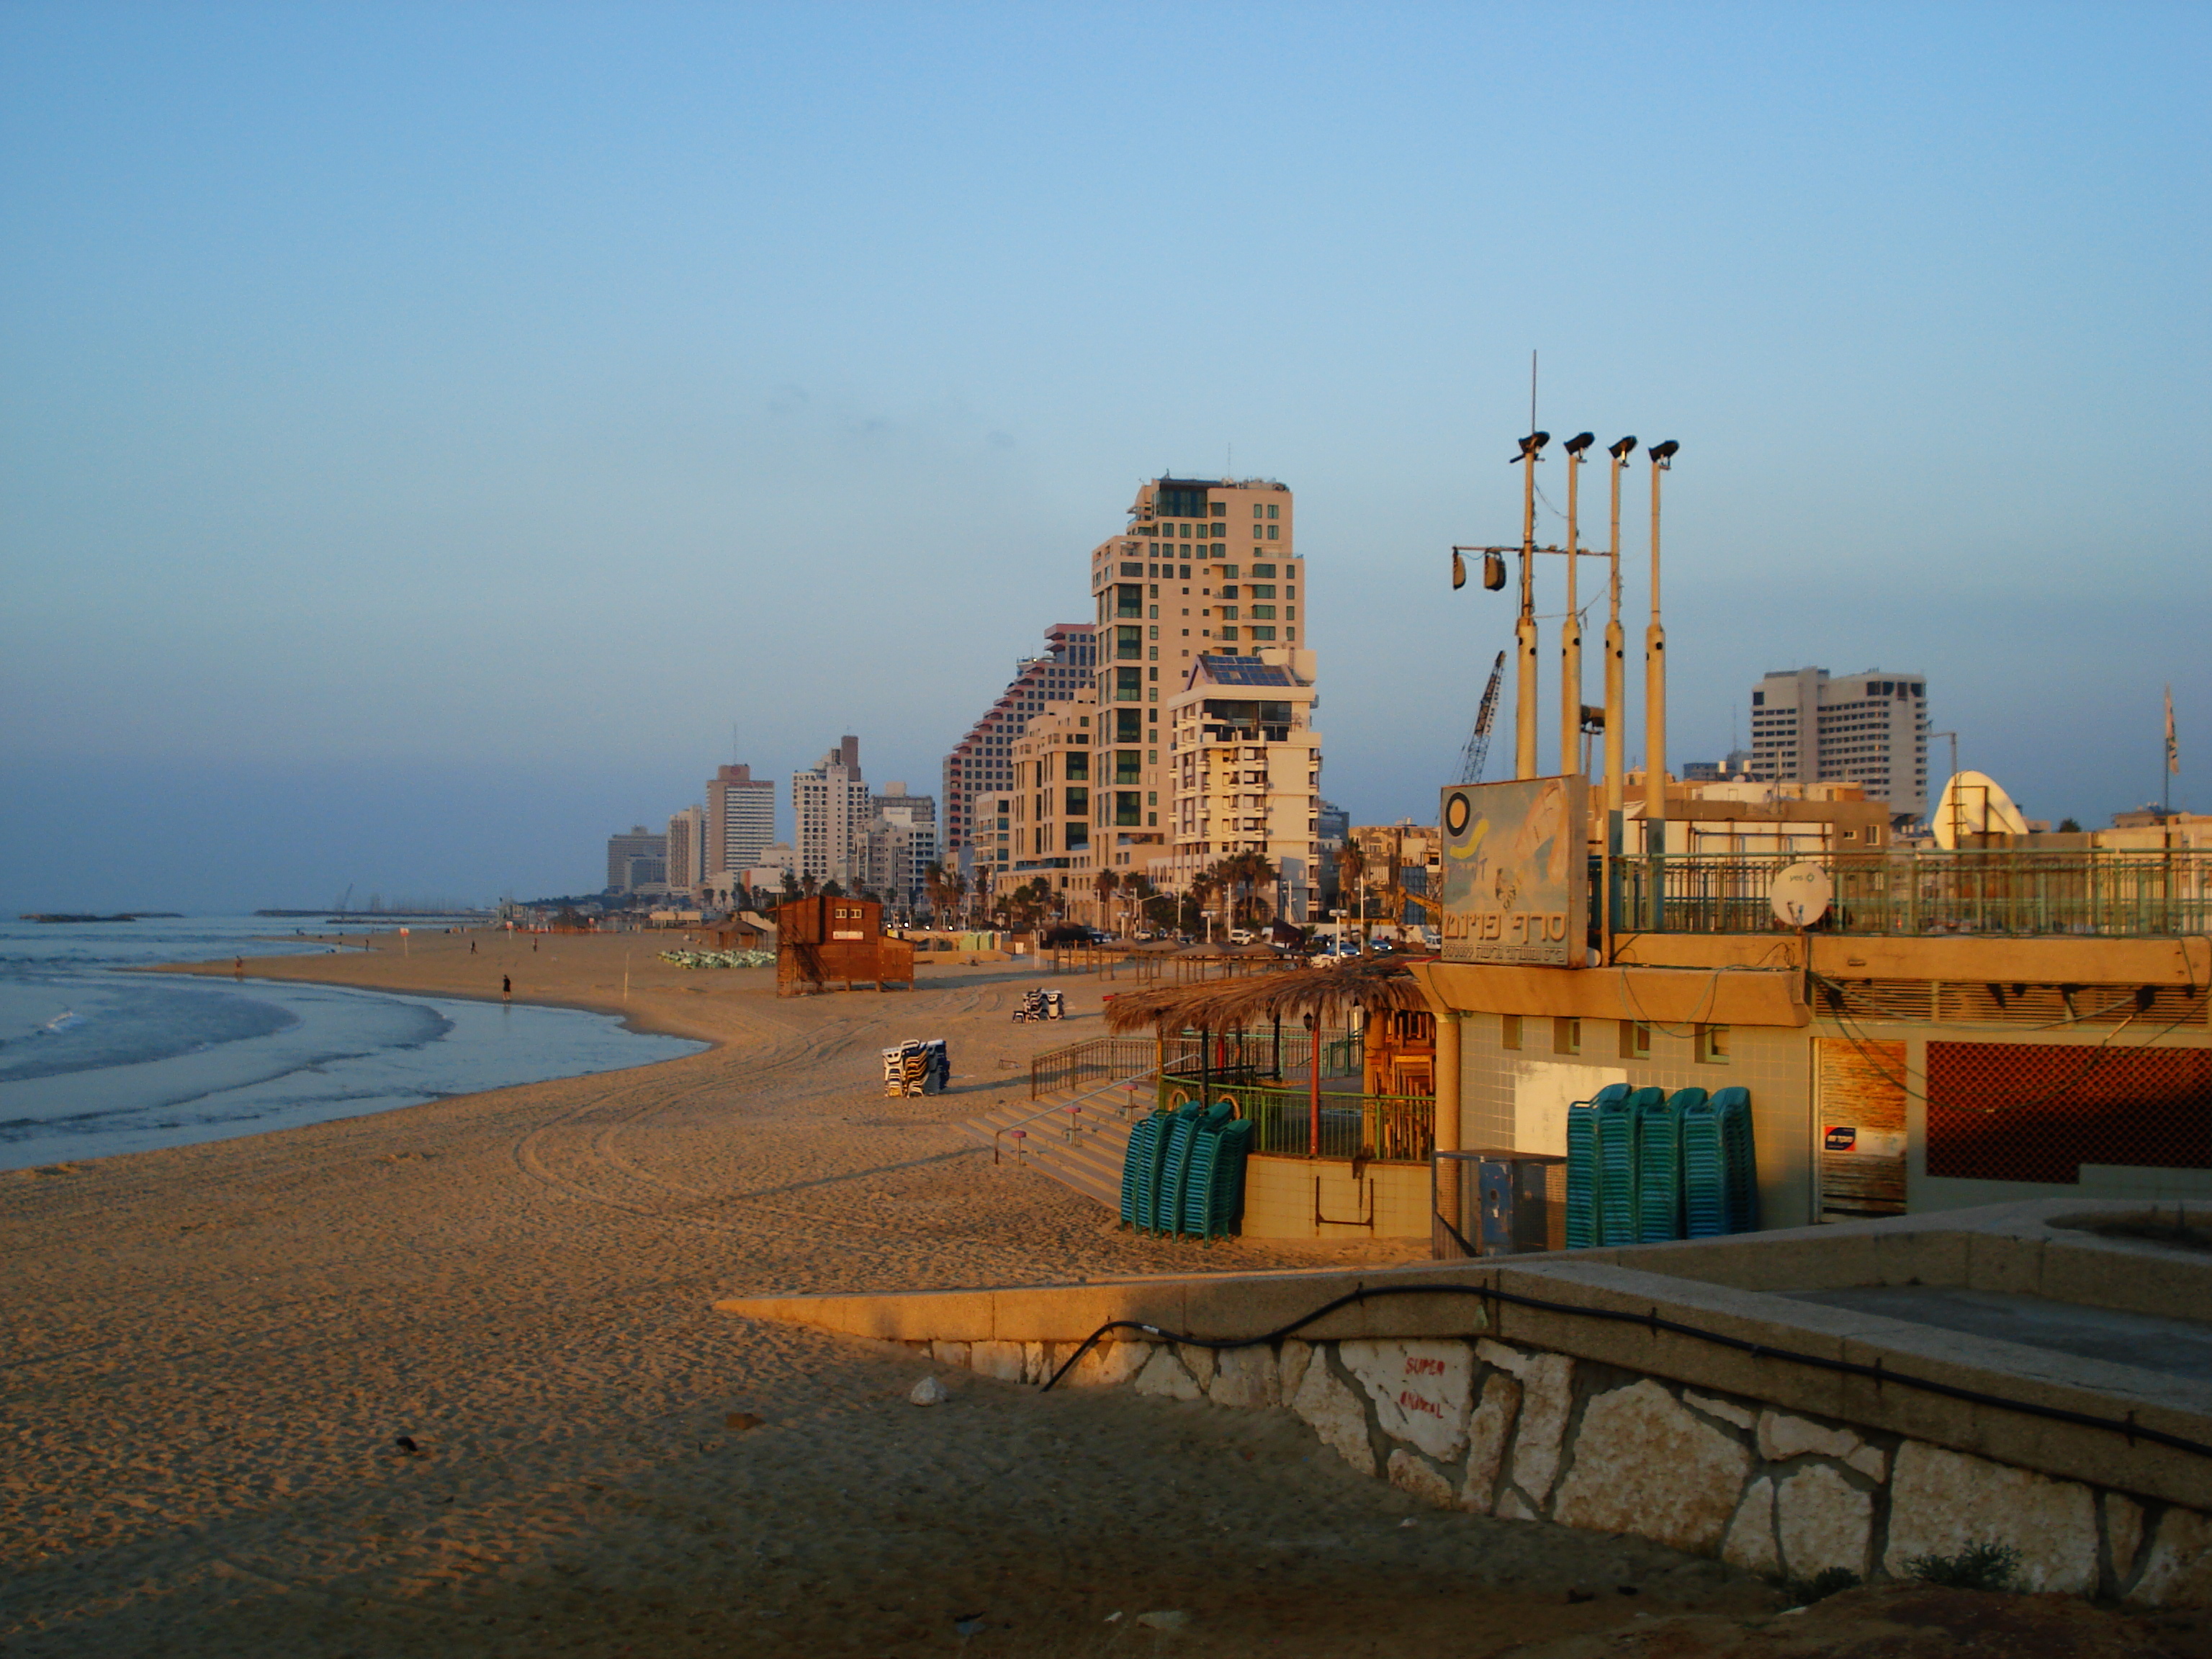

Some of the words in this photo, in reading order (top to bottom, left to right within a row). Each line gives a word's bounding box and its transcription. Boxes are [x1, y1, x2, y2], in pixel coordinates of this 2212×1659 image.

[1444, 911, 1501, 940] פוינט
[1513, 912, 1566, 944] סרף
[1405, 1357, 1445, 1376] SUPER
